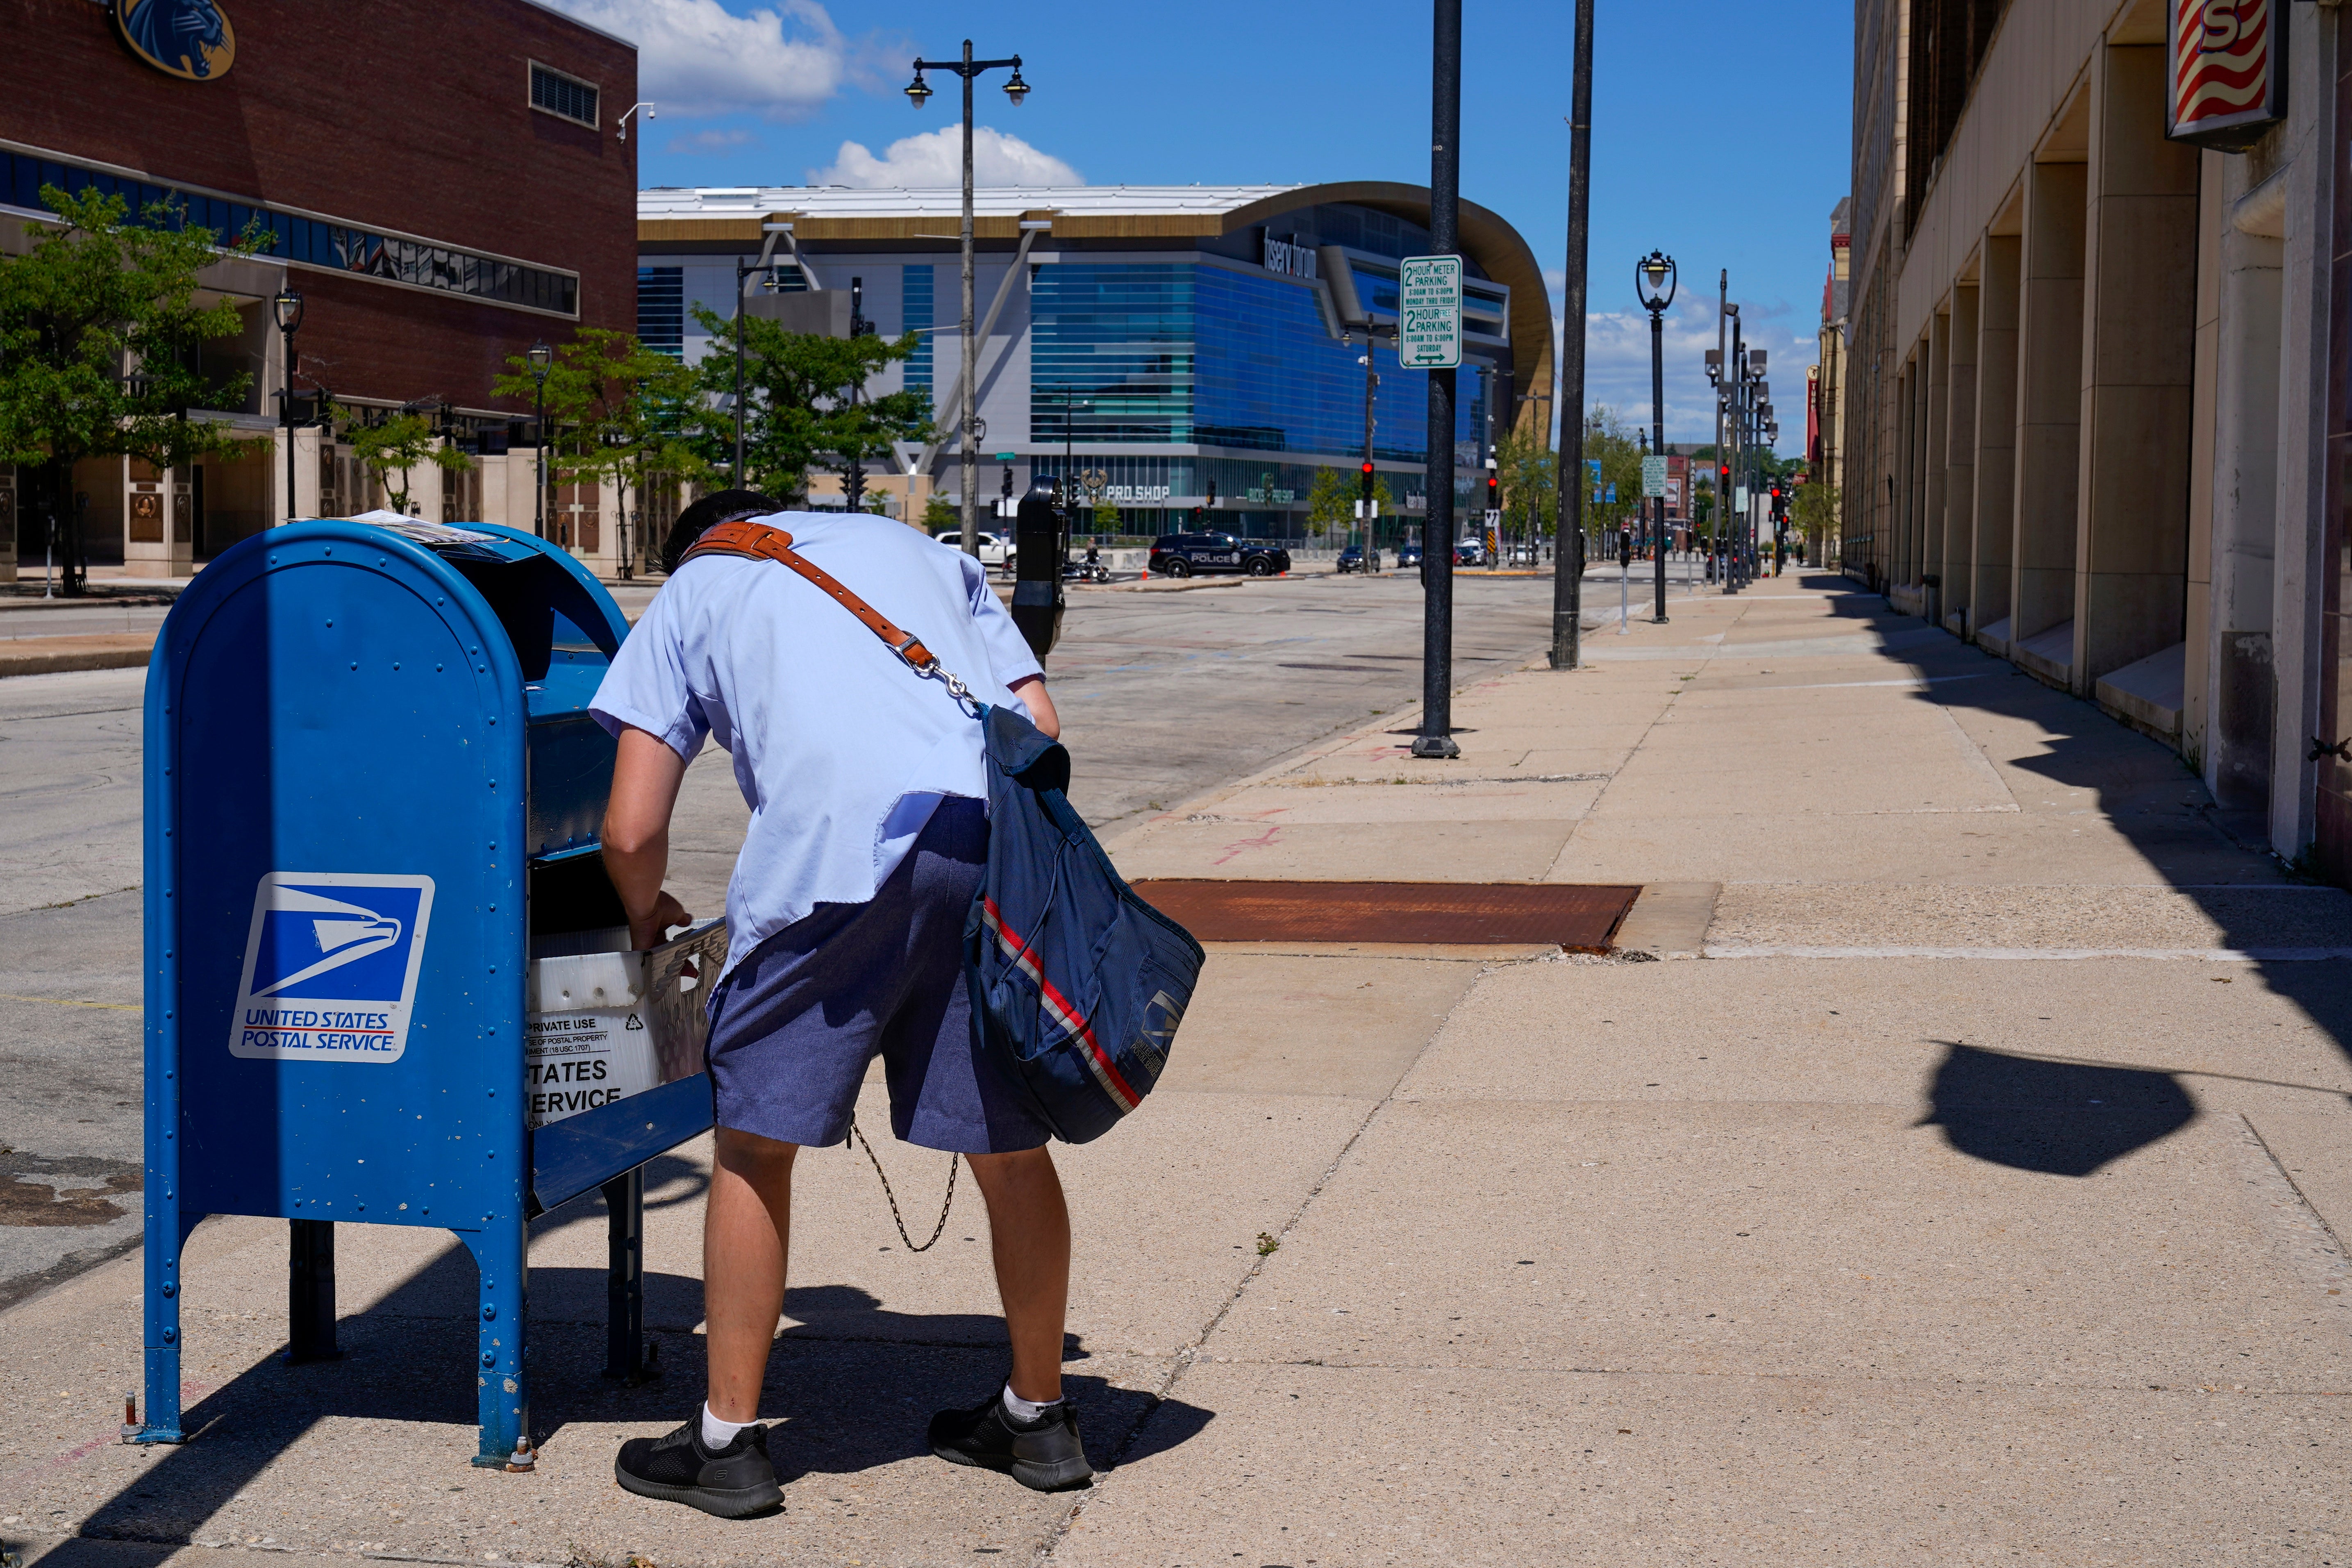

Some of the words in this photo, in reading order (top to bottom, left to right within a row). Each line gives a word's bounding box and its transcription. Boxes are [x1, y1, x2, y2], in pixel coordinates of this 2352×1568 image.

[1405, 267, 1412, 286] 2
[1413, 266, 1430, 275] HOUR
[1434, 264, 1455, 275] METER
[1415, 276, 1447, 286] PARKING
[1407, 310, 1415, 332] 2
[1416, 309, 1439, 320] HOUR
[1440, 309, 1451, 317] FREE
[1416, 321, 1452, 332] PARKING
[1406, 334, 1424, 343] 8:00AM
[1107, 485, 1132, 501] PRO
[1135, 485, 1170, 501] SHOP
[245, 1009, 318, 1027] UNITED
[321, 1011, 389, 1029] STATES
[574, 1018, 596, 1029] USE
[241, 1031, 312, 1049] POSTAL
[316, 1034, 394, 1052] SERVICE
[548, 1036, 572, 1045] POSTAL
[573, 1034, 607, 1043] PROPERTY
[550, 1046, 559, 1055] (18
[1130, 1043, 1147, 1064] POSTAL
[1144, 1060, 1157, 1077] SERVICE
[1136, 1036, 1154, 1057] UNITED
[1150, 1054, 1163, 1069] STATES
[529, 1060, 607, 1084] TATES
[532, 1088, 621, 1114] ERVICE
